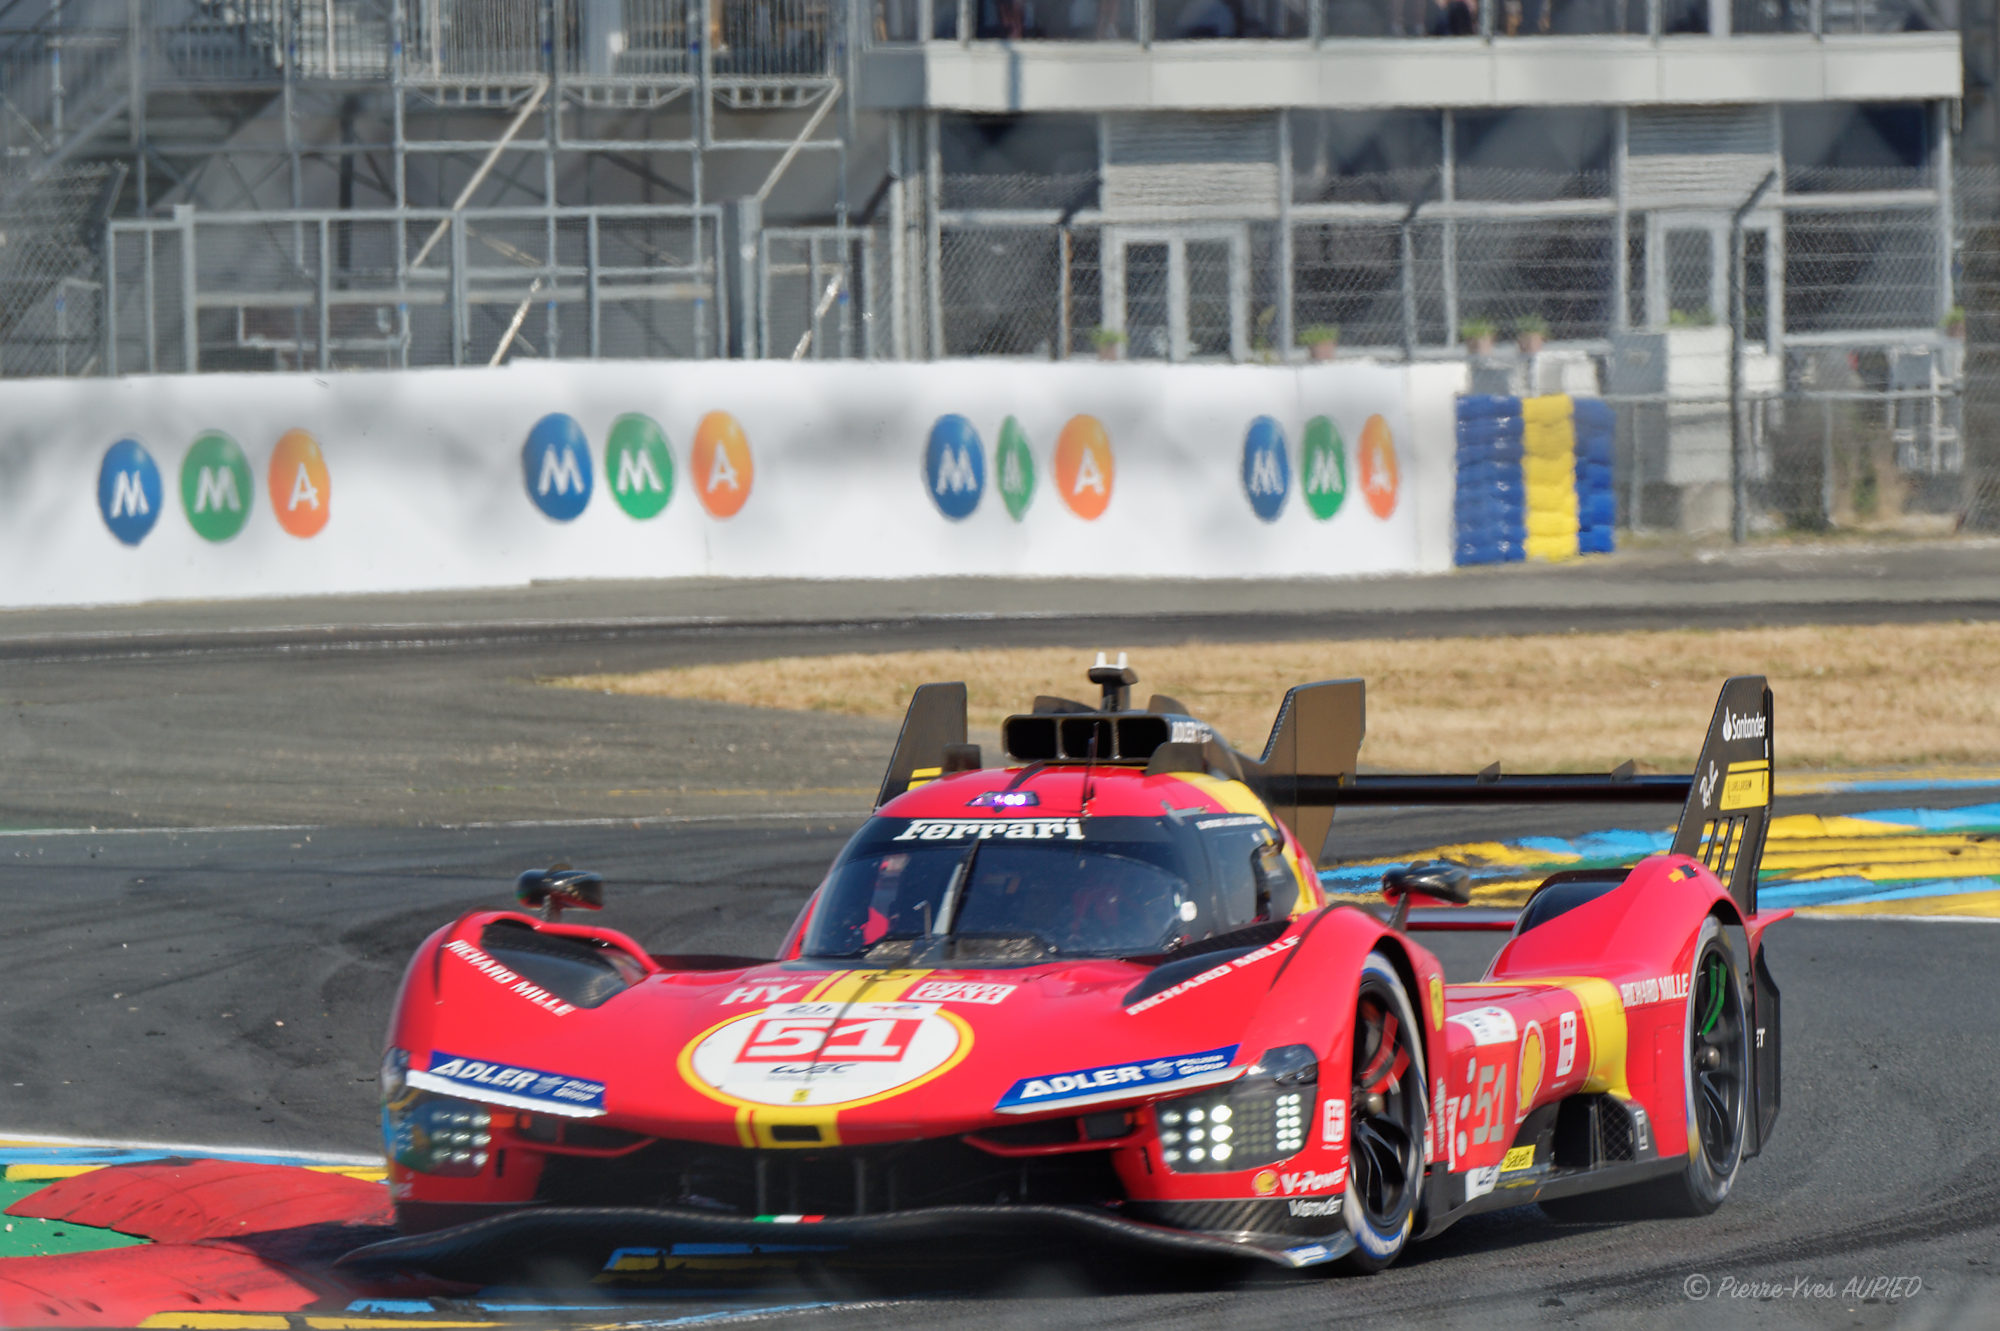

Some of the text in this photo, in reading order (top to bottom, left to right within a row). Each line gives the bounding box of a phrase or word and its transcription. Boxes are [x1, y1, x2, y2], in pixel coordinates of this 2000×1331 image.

[1732, 711, 1767, 740] Santander
[893, 817, 1086, 841] Ferrari
[509, 980, 577, 1017] MILLE
[720, 984, 803, 1005] HY
[1126, 964, 1233, 1016] RICHARD
[1658, 972, 1689, 1001] MILLE
[744, 1019, 903, 1058] 51
[430, 1058, 540, 1093] ADLER
[1020, 1066, 1145, 1099] ADLER
[1472, 1063, 1508, 1146] 51
